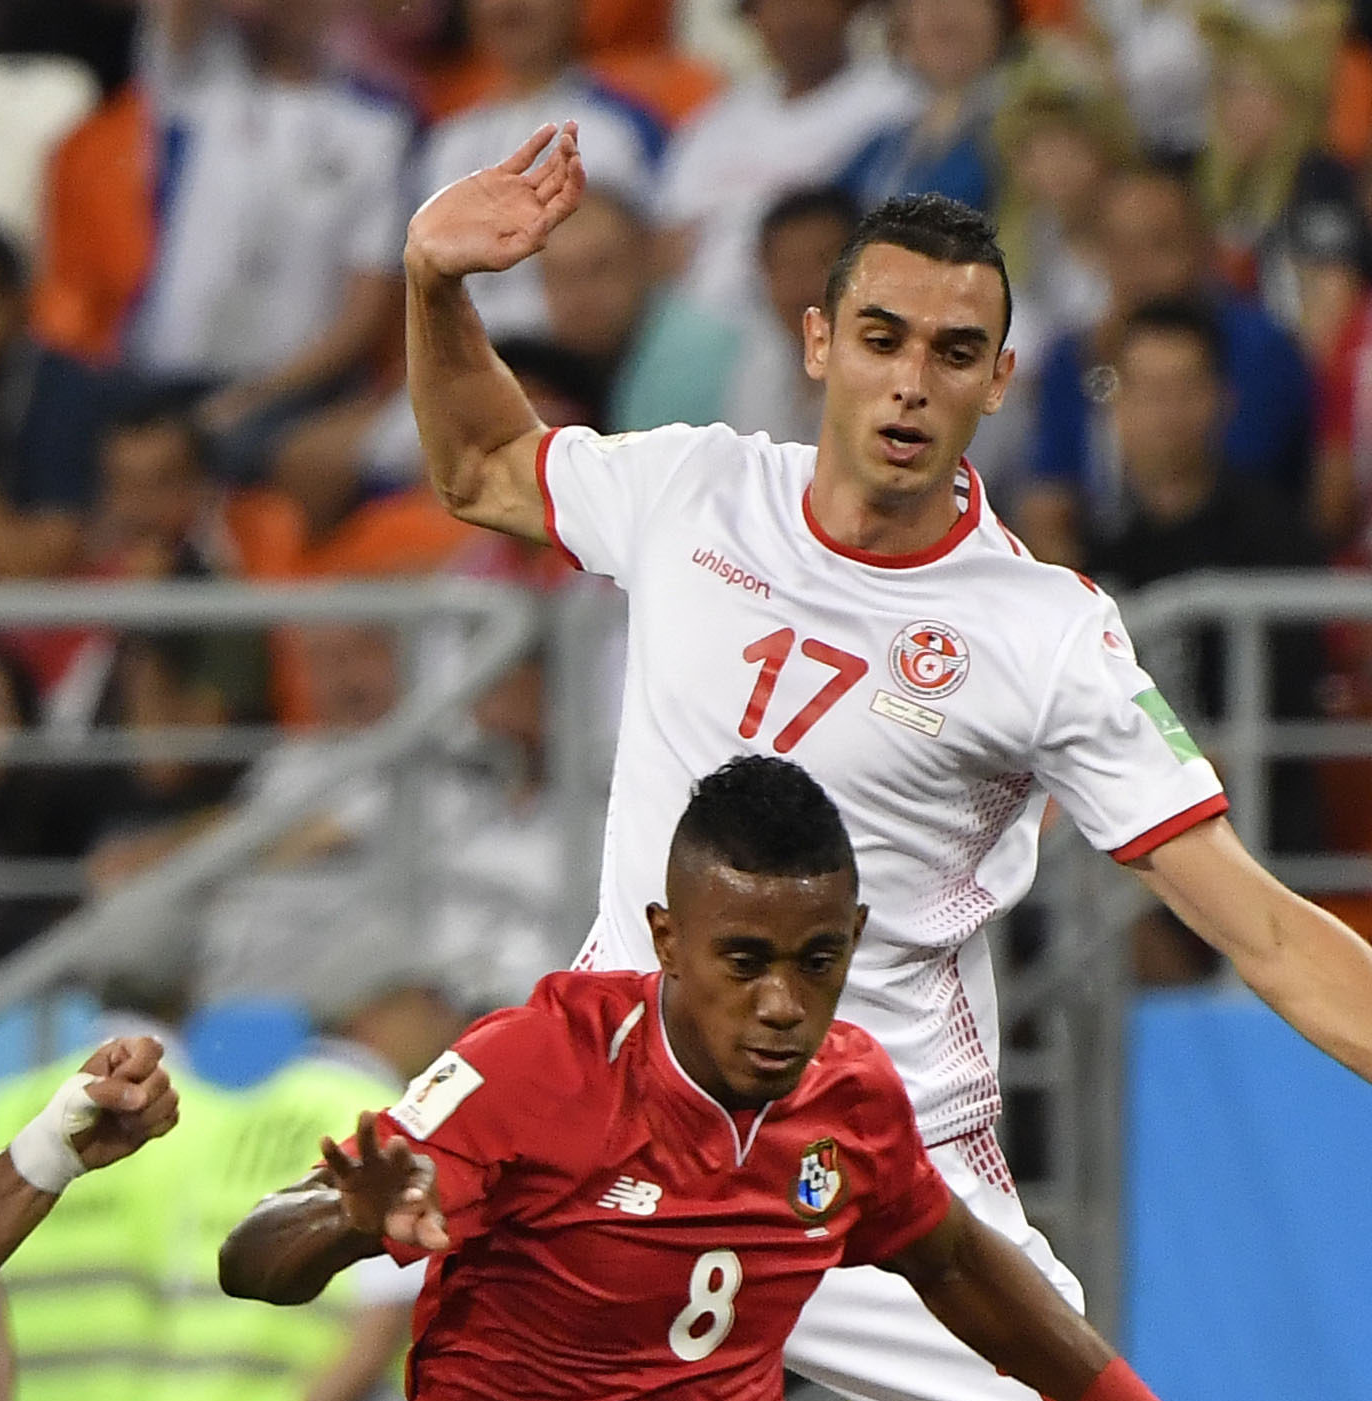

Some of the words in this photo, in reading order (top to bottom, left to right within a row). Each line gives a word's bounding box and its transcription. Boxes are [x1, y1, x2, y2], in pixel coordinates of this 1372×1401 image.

[692, 548, 771, 599] uhlsport
[738, 627, 869, 754] 17
[669, 1249, 743, 1361] 8
